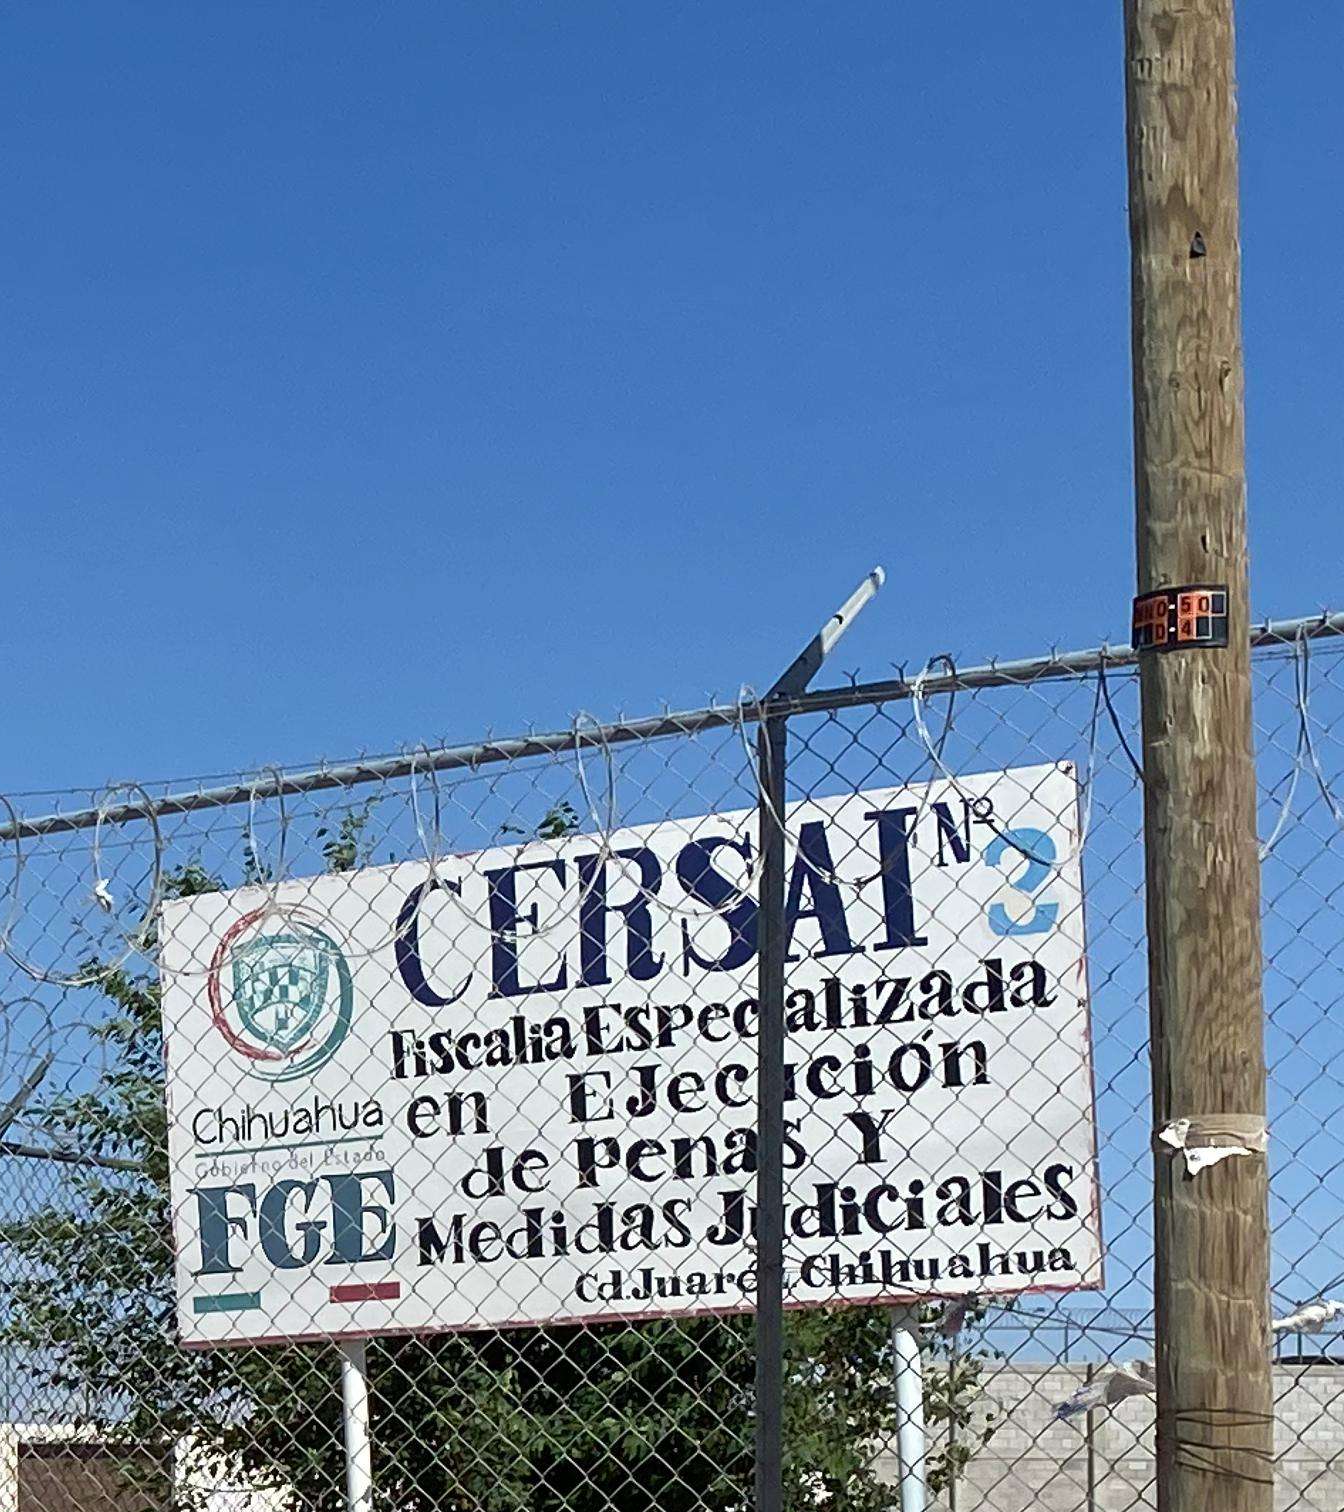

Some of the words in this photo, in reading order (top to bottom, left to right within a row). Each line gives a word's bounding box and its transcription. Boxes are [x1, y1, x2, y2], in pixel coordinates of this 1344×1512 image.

[393, 805, 928, 1007] CERSAI
[389, 1014, 578, 1080] Fiscalia
[582, 957, 1060, 1057] Especalizada
[191, 1097, 386, 1145] Chihuahua
[406, 1090, 491, 1139] en
[194, 1158, 281, 1180] Gobierno
[288, 1152, 313, 1171] del
[323, 1148, 386, 1168] Estado
[460, 1146, 552, 1200] de
[842, 1108, 896, 1165] Y
[185, 1168, 397, 1278] FGE
[414, 1197, 693, 1267] Medidas
[800, 1242, 1076, 1288] Chihuahua
